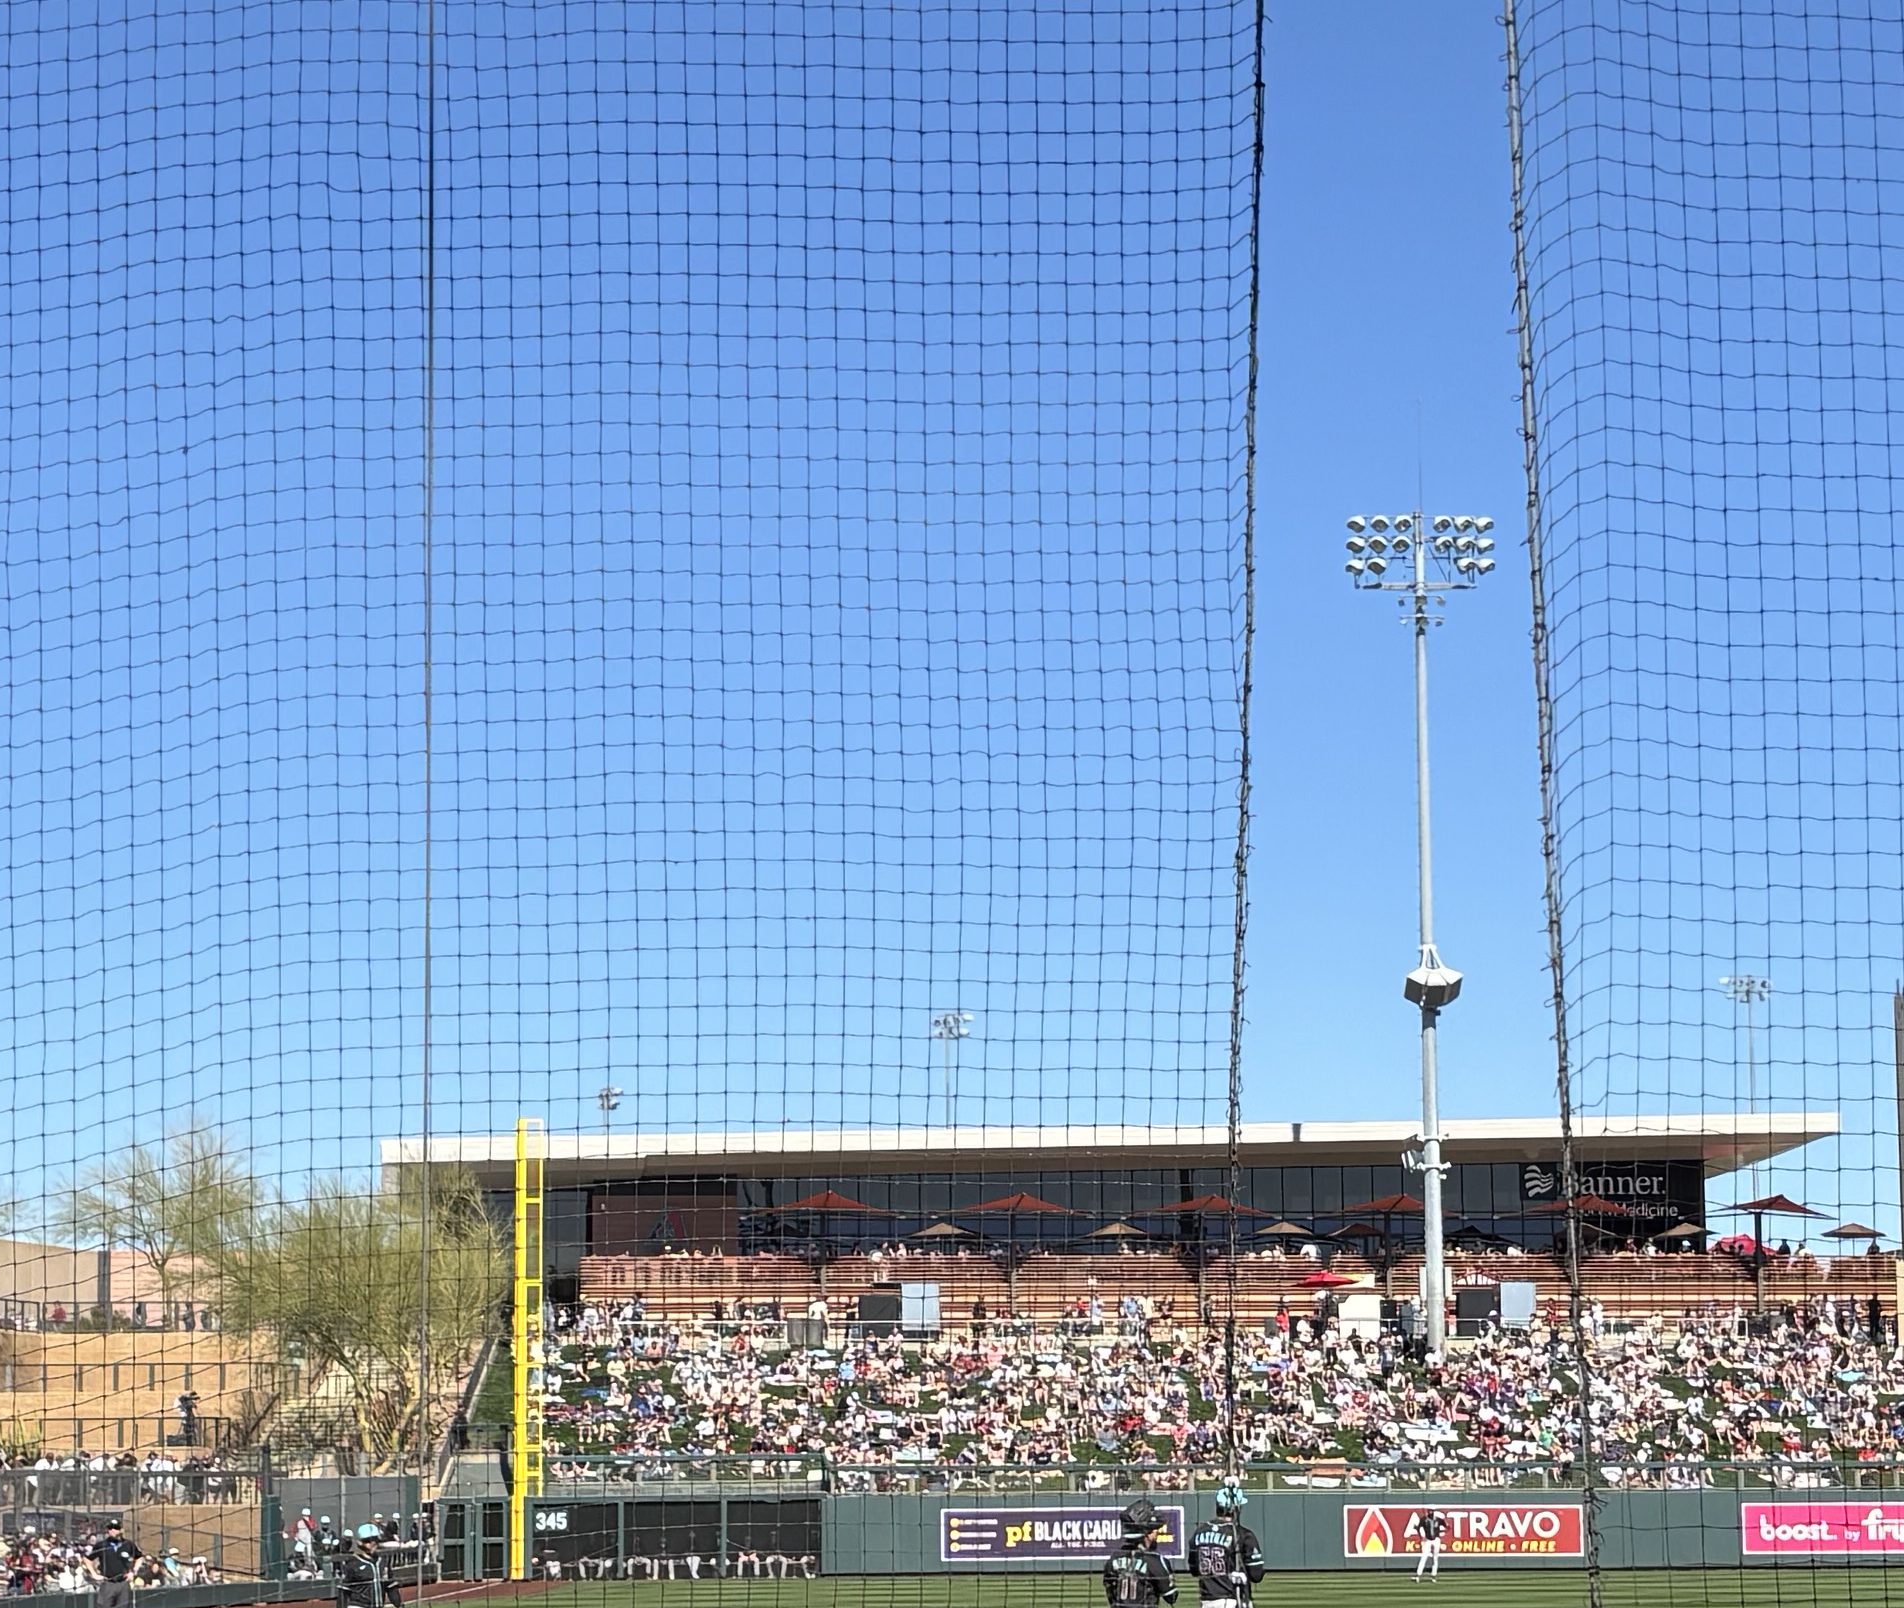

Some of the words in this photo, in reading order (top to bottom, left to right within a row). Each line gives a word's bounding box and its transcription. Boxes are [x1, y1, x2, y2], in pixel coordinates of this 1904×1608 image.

[535, 1512, 567, 1530] 345
[1006, 1521, 1034, 1547] pf
[1034, 1520, 1082, 1542] BLACK
[1845, 1529, 1861, 1543] by
[1452, 1541, 1504, 1552] ONLINE
[1521, 1541, 1556, 1552] FREE
